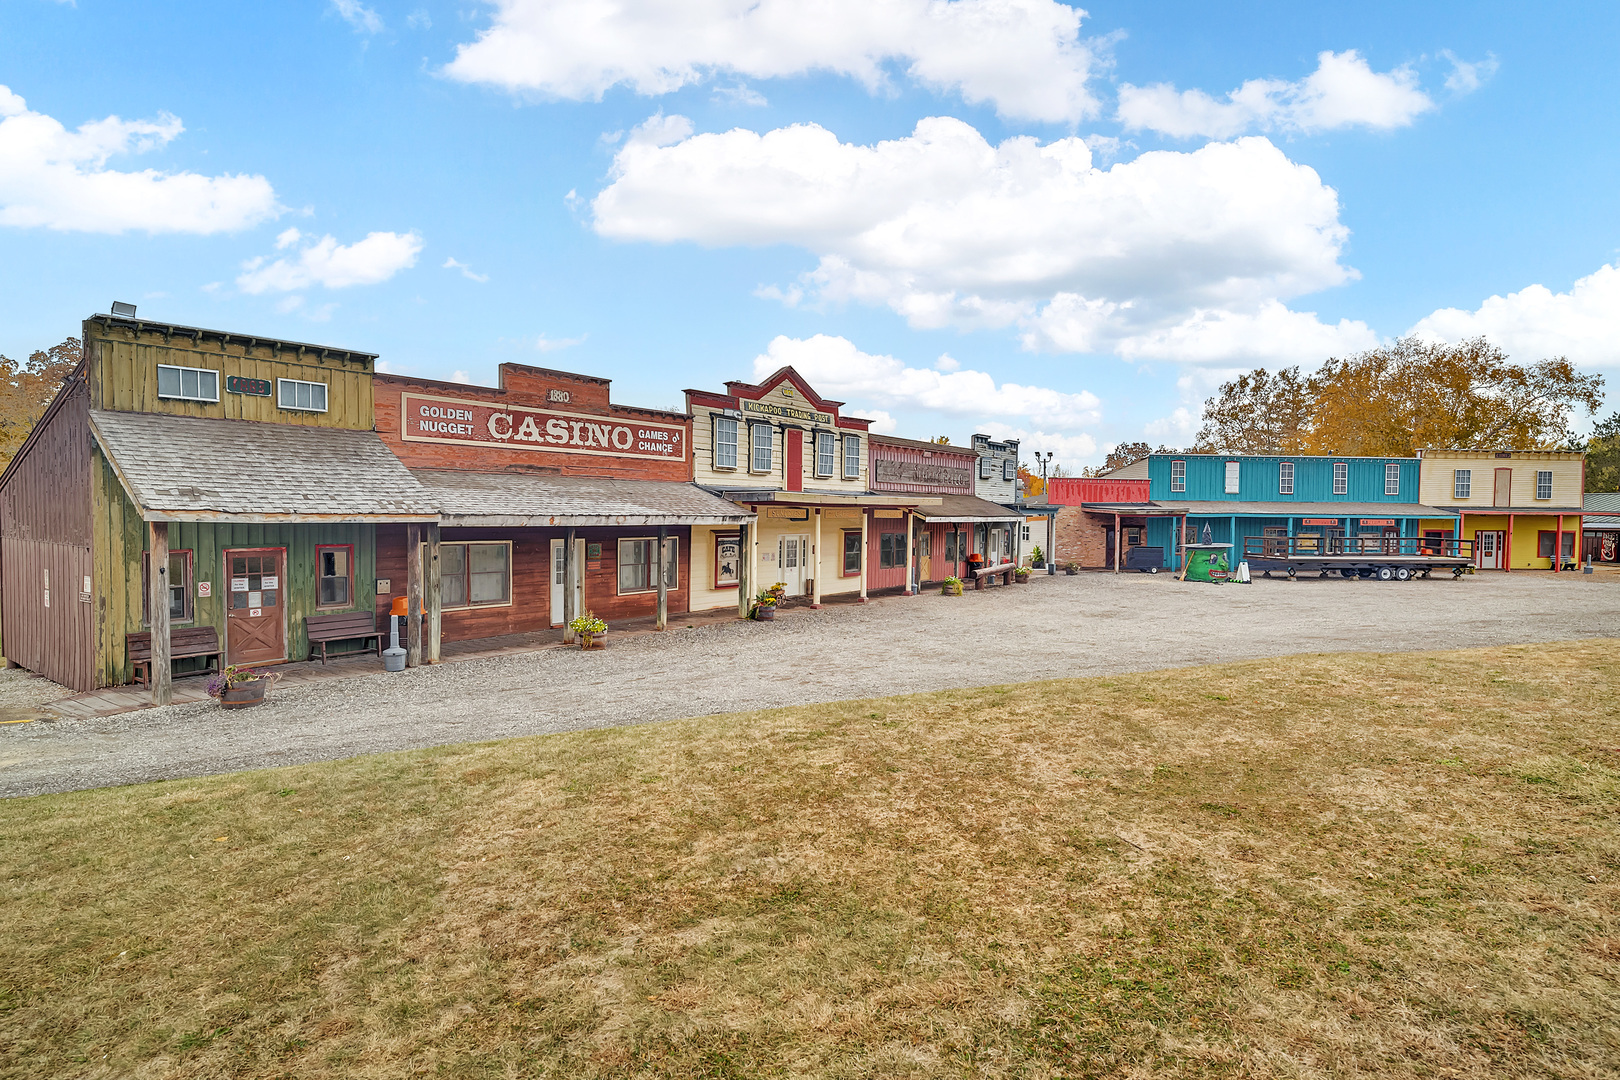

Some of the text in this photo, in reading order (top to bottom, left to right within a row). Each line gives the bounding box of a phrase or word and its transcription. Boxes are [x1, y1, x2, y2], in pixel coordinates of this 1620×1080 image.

[232, 378, 265, 394] 1883
[550, 389, 570, 403] 1880
[419, 405, 473, 422] GOLDEN
[748, 402, 829, 423] KICKAPOO TRADING POST
[419, 420, 474, 435] NUGGET
[486, 412, 634, 450] CASINO
[638, 429, 669, 441] GAMES
[638, 441, 673, 453] CHANCE
